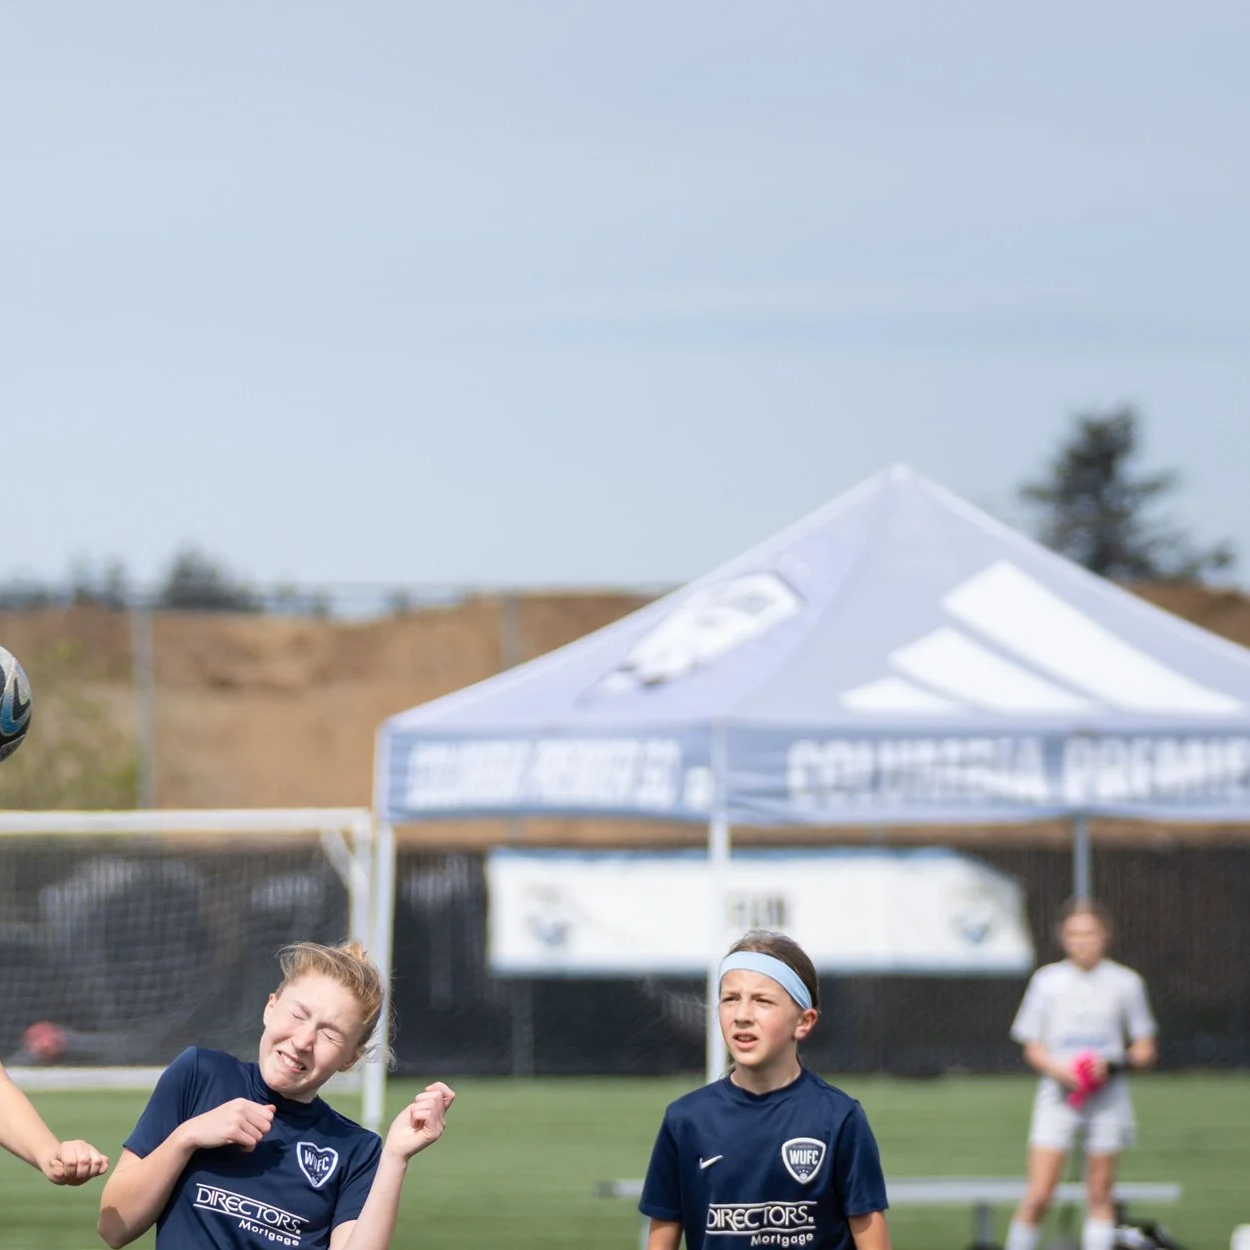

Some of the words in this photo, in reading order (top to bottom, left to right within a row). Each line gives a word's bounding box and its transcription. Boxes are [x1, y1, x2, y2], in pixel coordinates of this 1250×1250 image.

[789, 1149, 819, 1165] WUFC
[196, 1186, 298, 1234] DIRECTORS
[707, 1206, 810, 1232] DIRECTORS
[238, 1219, 300, 1247] Mortgage
[750, 1233, 815, 1249] Mortgage
